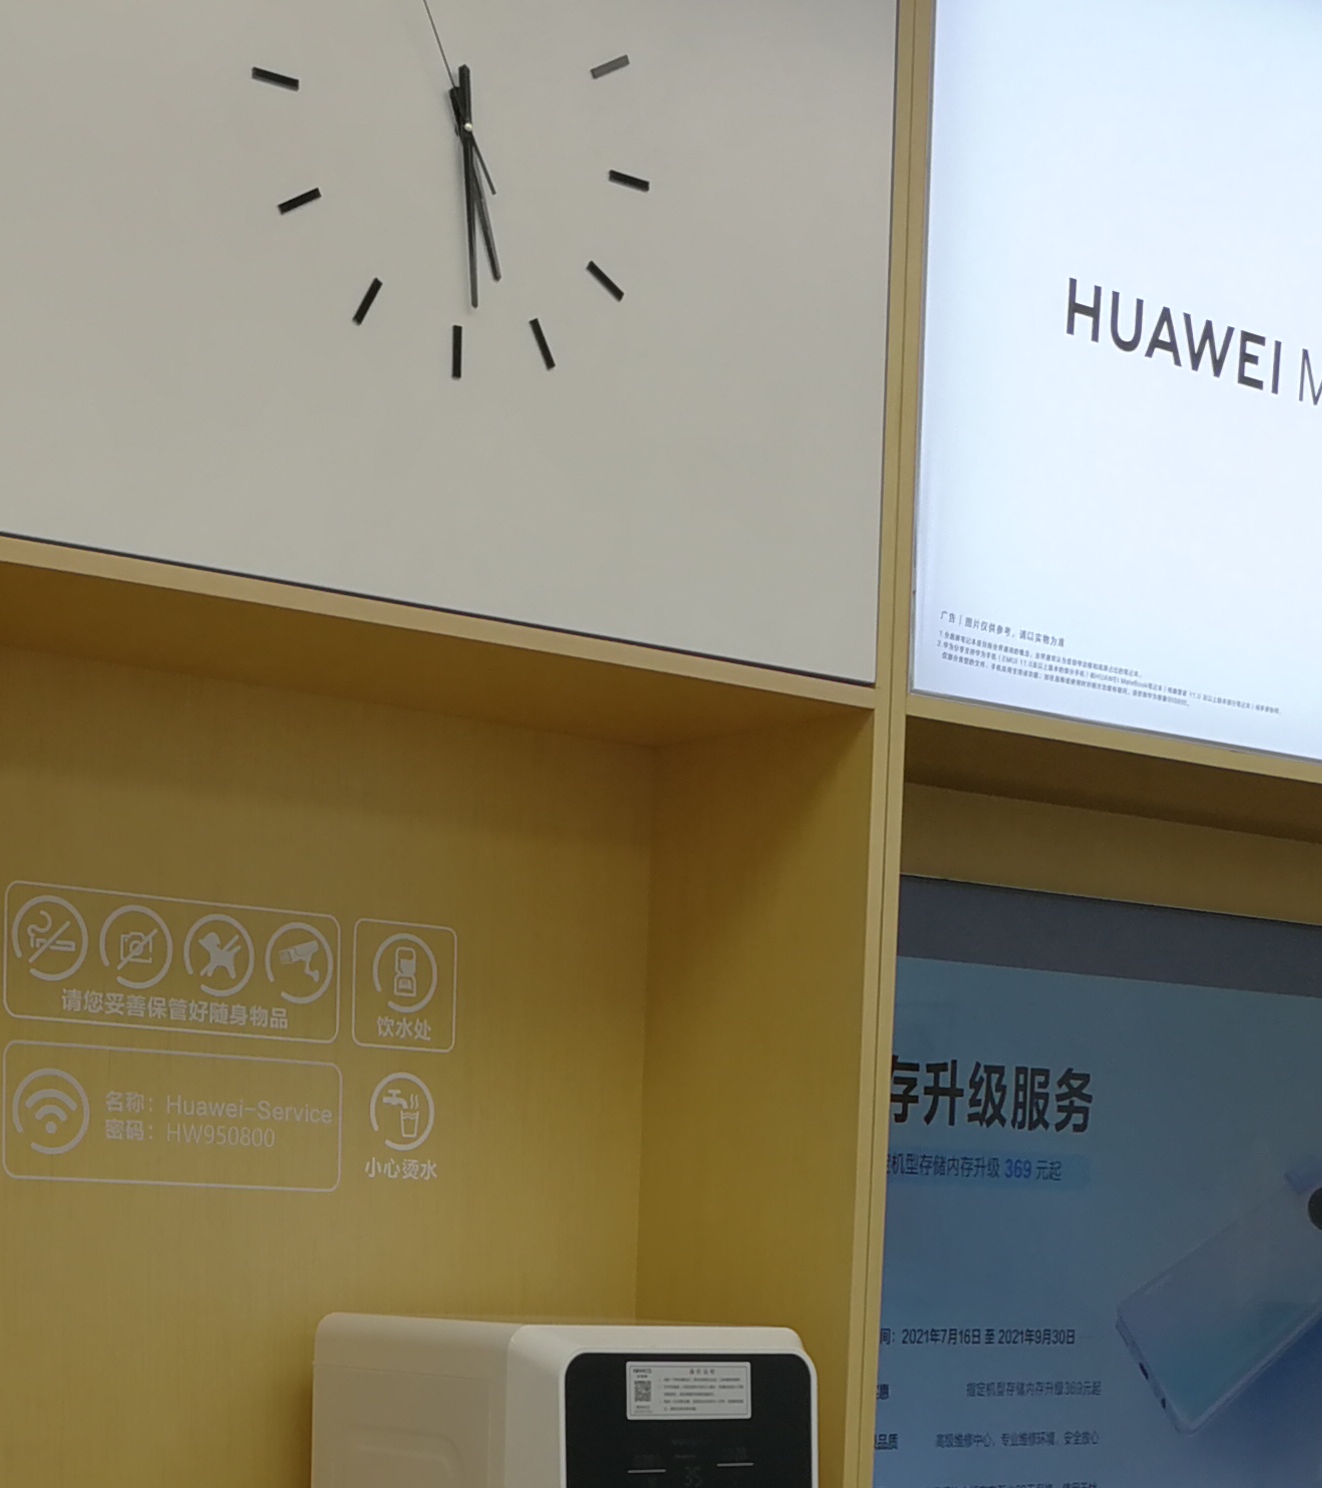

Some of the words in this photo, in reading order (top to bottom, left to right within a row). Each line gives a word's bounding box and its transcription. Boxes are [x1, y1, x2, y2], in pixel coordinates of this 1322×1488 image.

[1066, 277, 1282, 395] HUAWEI
[940, 610, 956, 624] 广告
[61, 988, 289, 1030] 请您妥善保管好随身物品
[376, 1017, 432, 1042] 饮水处
[890, 1054, 1094, 1134] 存升级服务
[165, 1095, 333, 1126] Huawei-Service
[166, 1123, 276, 1149] HW950800
[364, 1157, 438, 1181] 小心烫水
[1004, 1158, 1032, 1179] 369
[1036, 1159, 1063, 1181] 元起
[901, 1328, 981, 1346] 2021年7月16日
[984, 1328, 995, 1346] 至
[997, 1328, 1076, 1346] 2021年9月30日
[875, 1433, 899, 1450] 品质
